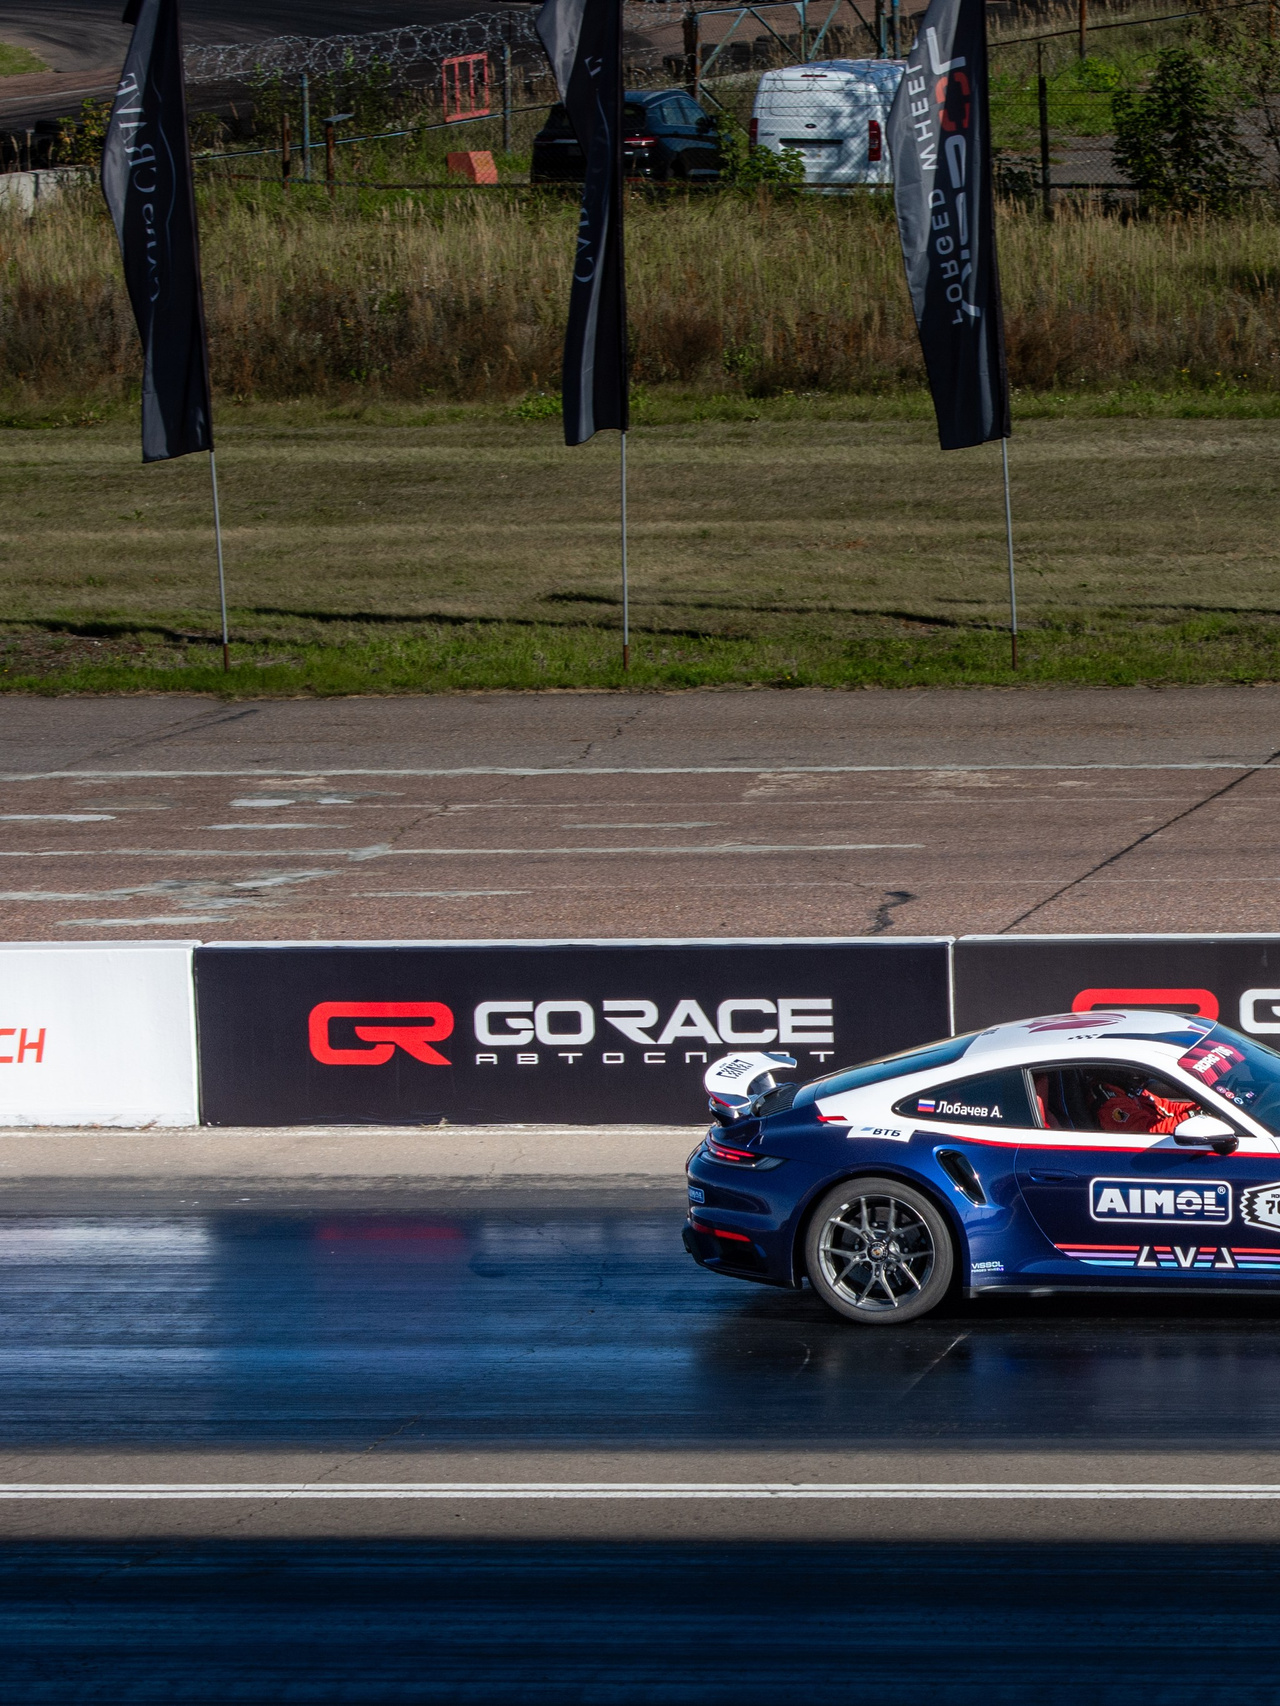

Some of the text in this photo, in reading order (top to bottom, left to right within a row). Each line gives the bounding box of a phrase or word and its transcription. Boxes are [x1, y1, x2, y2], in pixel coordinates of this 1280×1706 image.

[475, 1051, 835, 1065] АВТОСПТ
[936, 1101, 989, 1117] Лобачев
[872, 1128, 902, 1137] ВТБ
